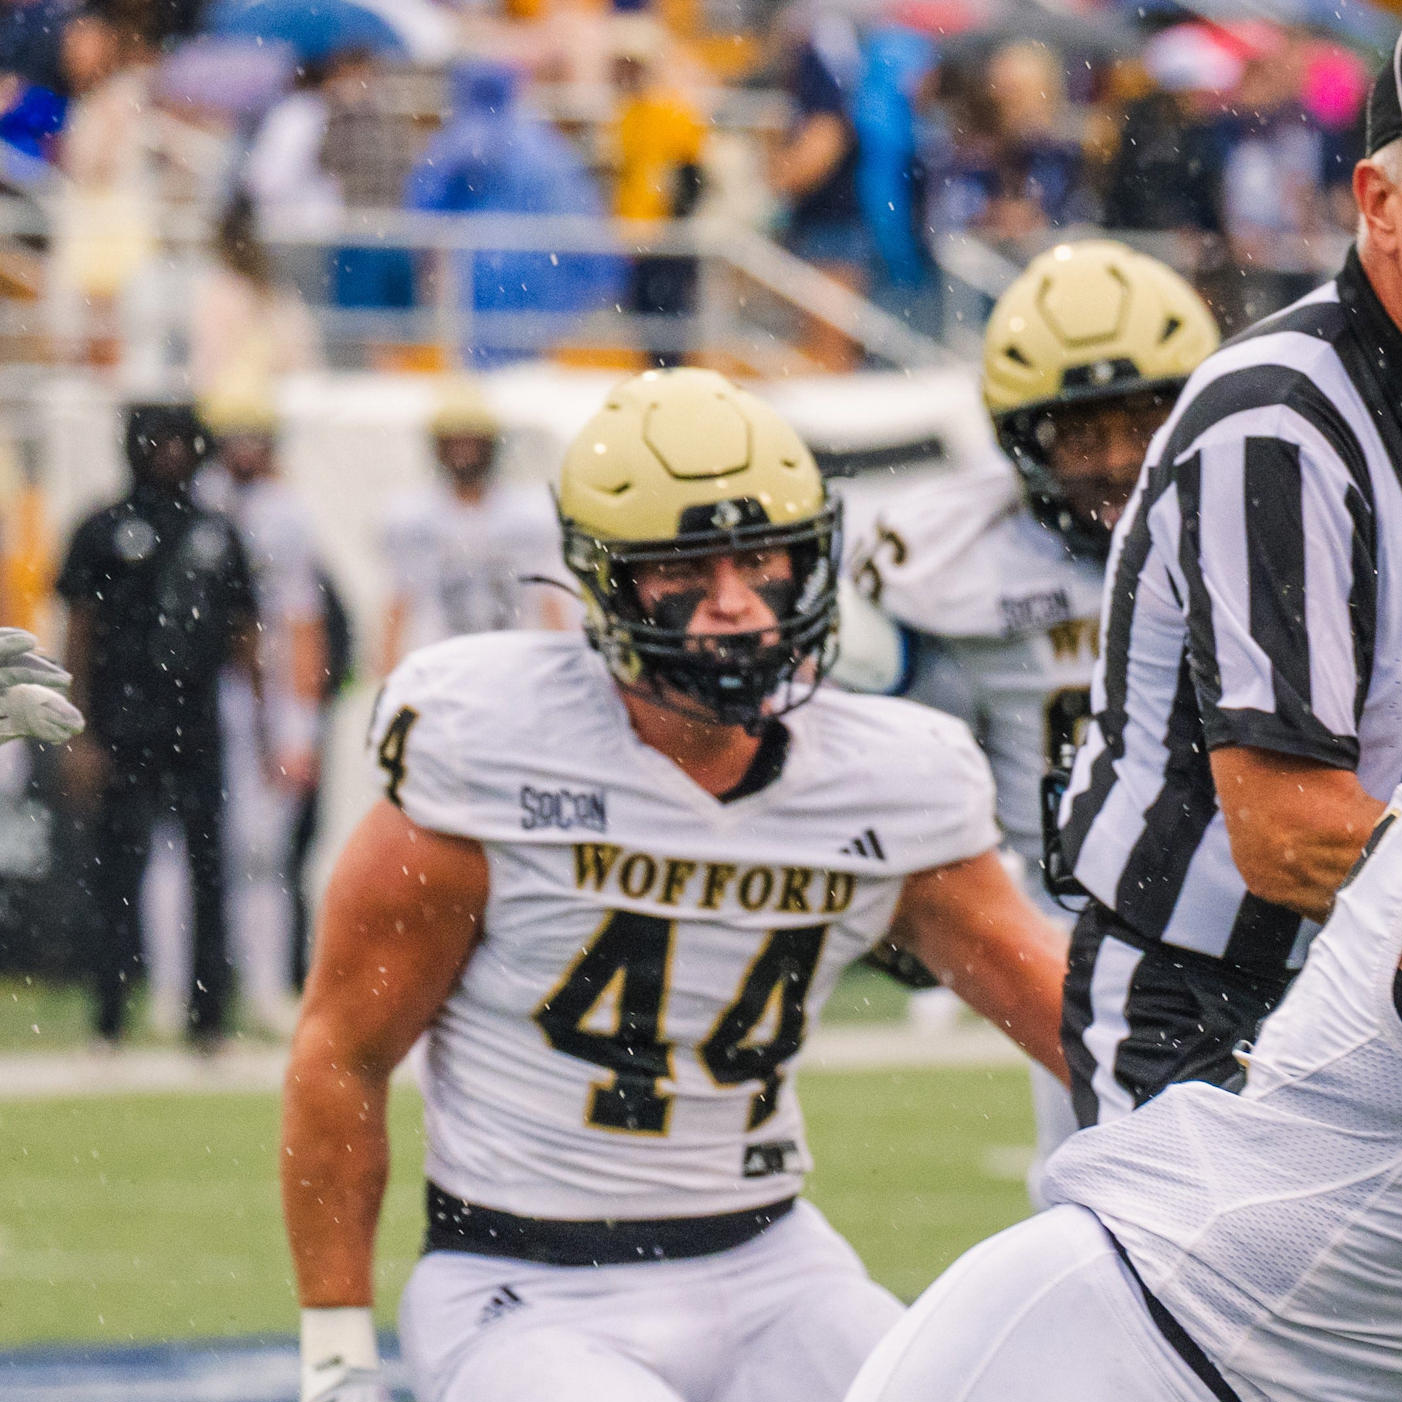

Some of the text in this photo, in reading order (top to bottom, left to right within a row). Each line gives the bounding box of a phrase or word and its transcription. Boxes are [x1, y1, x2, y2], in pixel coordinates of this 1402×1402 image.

[367, 684, 421, 811] 4
[571, 842, 858, 915] WOFFORD
[531, 907, 830, 1138] 44
